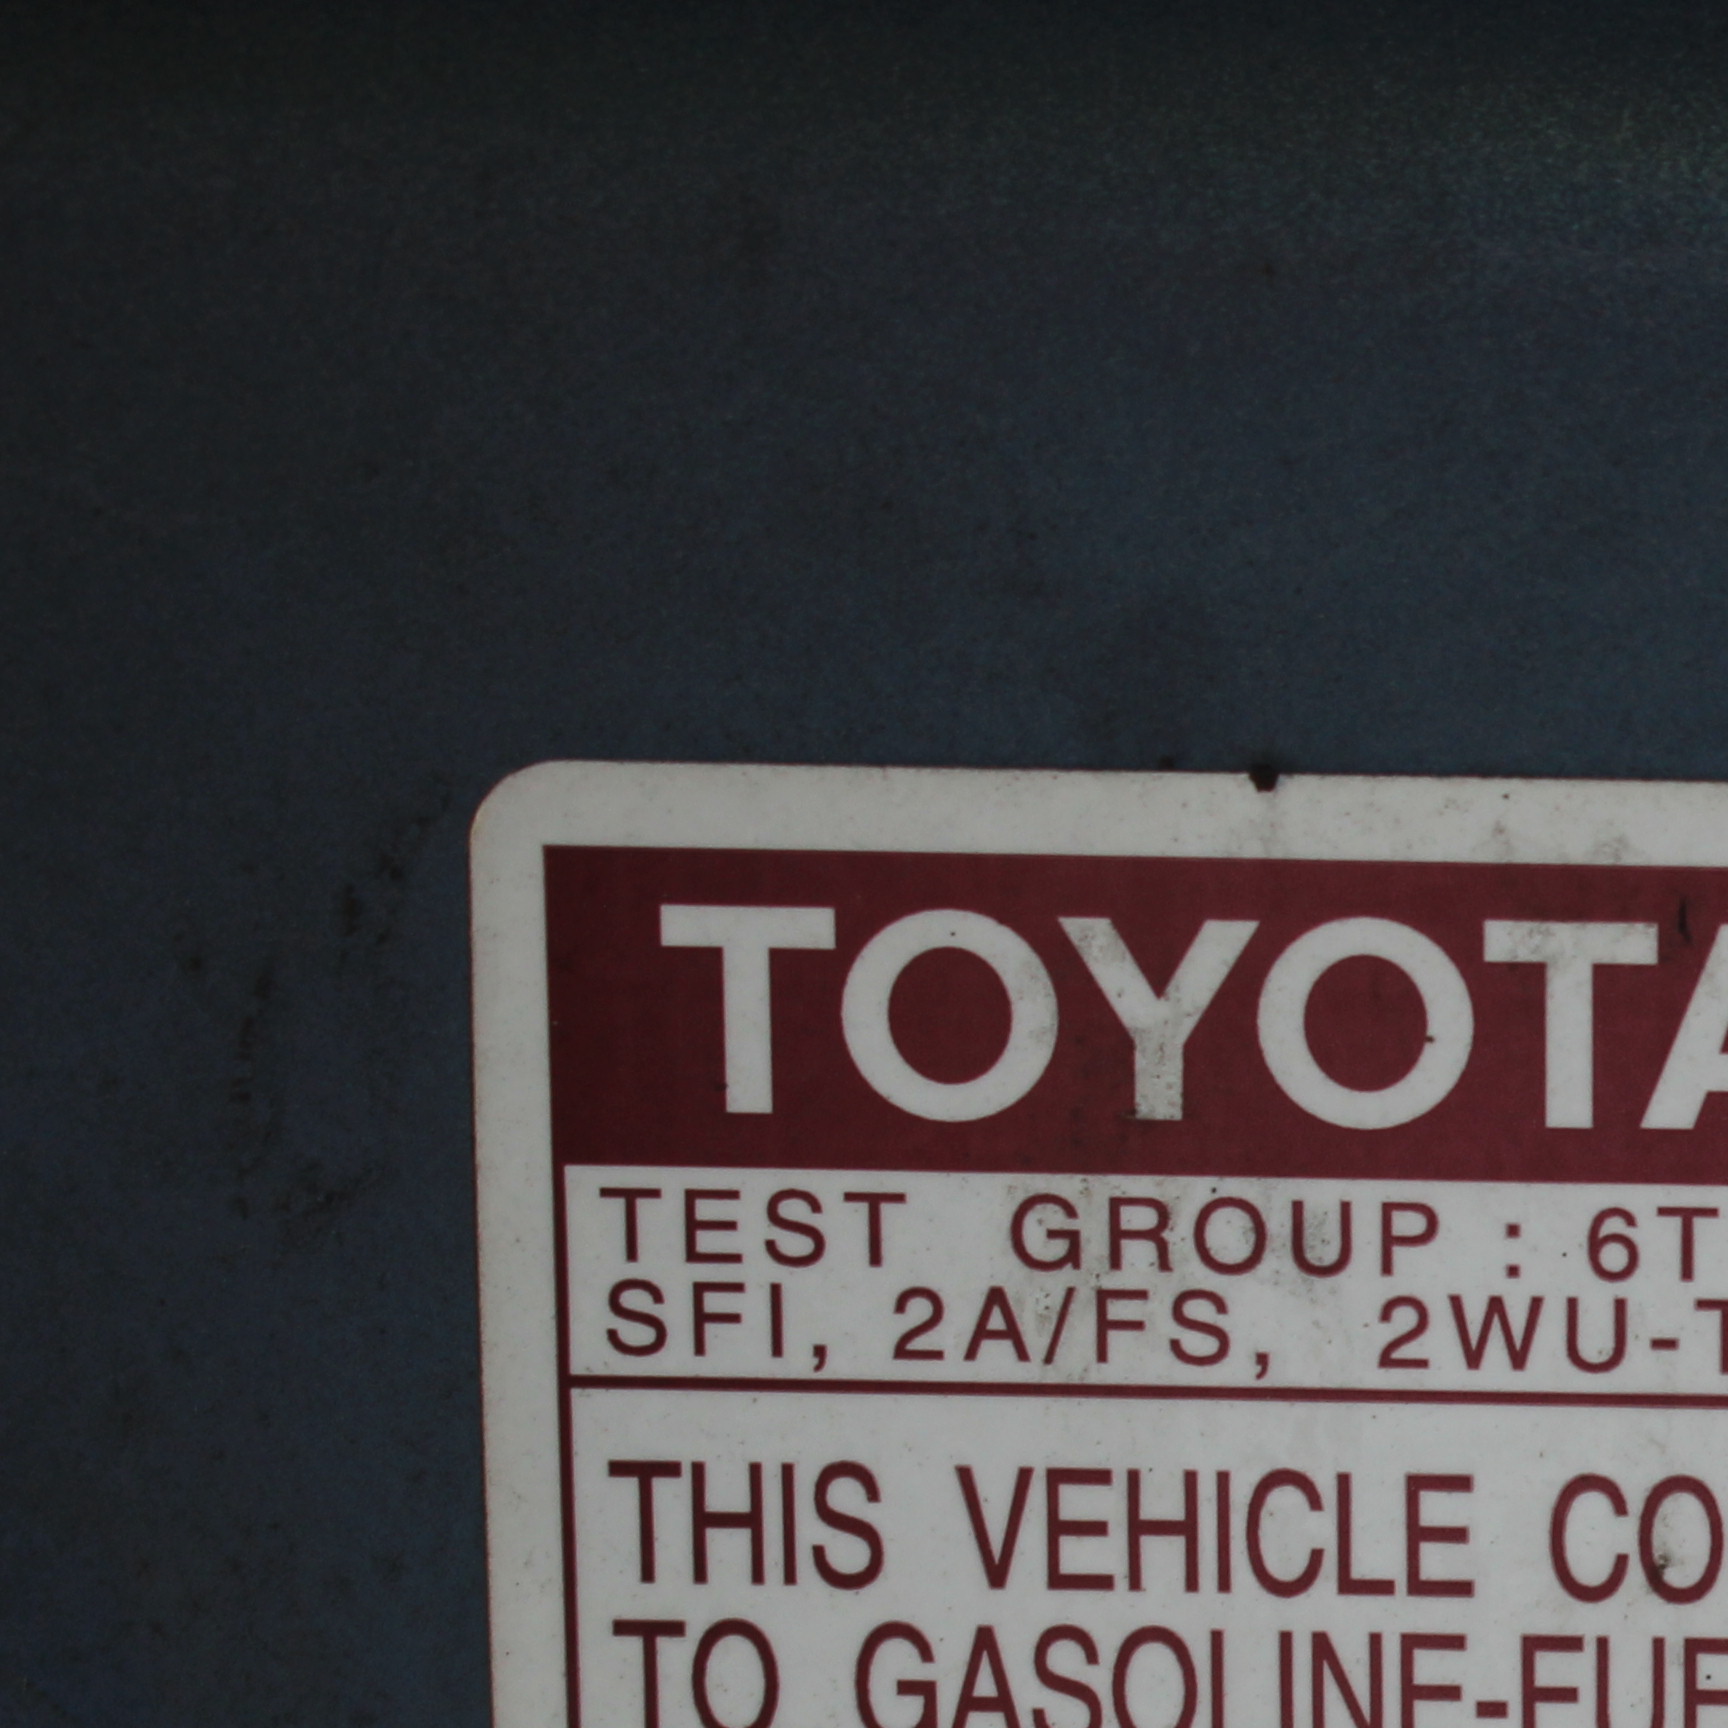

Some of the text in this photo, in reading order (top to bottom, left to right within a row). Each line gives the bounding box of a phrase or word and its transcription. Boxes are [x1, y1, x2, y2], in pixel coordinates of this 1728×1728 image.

[608, 1187, 906, 1268] TEST
[1009, 1193, 1439, 1278] GROUP
[606, 1278, 827, 1372] SFI,
[893, 1286, 1269, 1380] 2A/FS,
[607, 1460, 884, 1591] THIS
[955, 1465, 1475, 1598] VEHICLE
